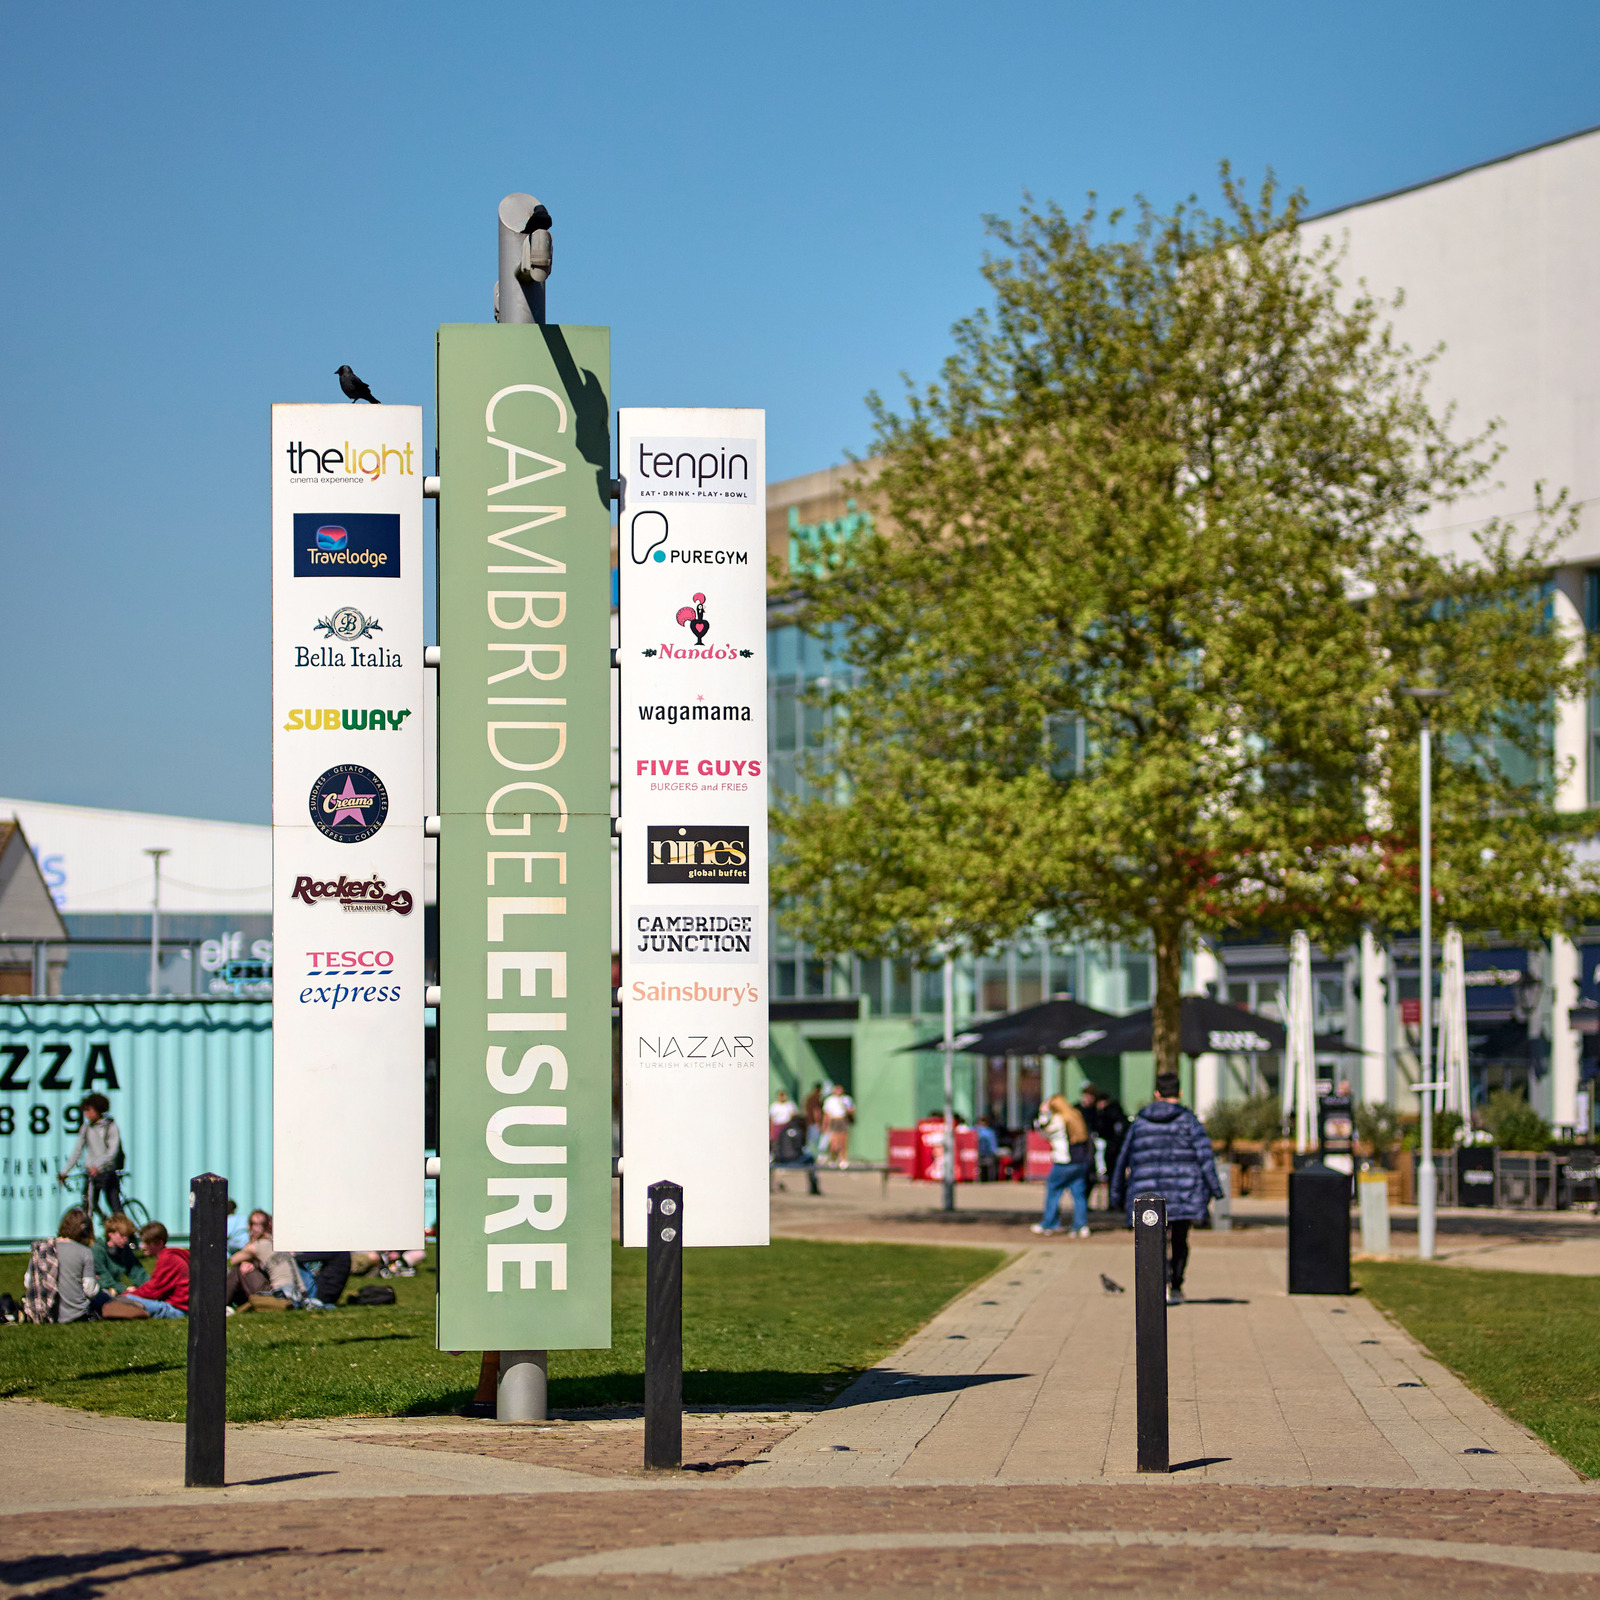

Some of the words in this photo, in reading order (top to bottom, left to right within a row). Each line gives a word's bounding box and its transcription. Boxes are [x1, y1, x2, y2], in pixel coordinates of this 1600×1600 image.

[640, 443, 748, 488] tenpin
[290, 476, 319, 484] cinema
[320, 476, 364, 485] experience
[307, 548, 388, 568] Travelodge
[670, 550, 748, 565] PUREGYM
[294, 646, 346, 668] Bella
[350, 646, 403, 668] Italia
[658, 643, 738, 660] Nando's
[283, 707, 412, 732] SUBWAY
[638, 705, 751, 725] wagamama
[333, 765, 364, 774] GELATO
[637, 759, 689, 776] FIVE
[697, 759, 762, 777] GUYS
[311, 776, 326, 811] SUNDAES
[372, 776, 388, 811] WAFFLES
[650, 782, 699, 792] BURGERS
[700, 782, 719, 792] and
[721, 782, 748, 792] FRIES
[322, 792, 374, 813] Creams
[316, 820, 343, 841] CREPES
[354, 820, 382, 841] COFFEE
[650, 827, 747, 866] nines
[688, 869, 716, 878] global
[718, 869, 747, 877] buffet
[291, 874, 386, 904] Rocker's
[637, 916, 752, 932] CAMBRIDGE
[637, 934, 751, 952] JUNCTION
[306, 950, 394, 968] TESCO
[299, 983, 401, 1010] express
[632, 981, 759, 1007] Sainsbury's
[639, 1036, 754, 1058] NAZAR
[0, 1043, 120, 1090] ZZA
